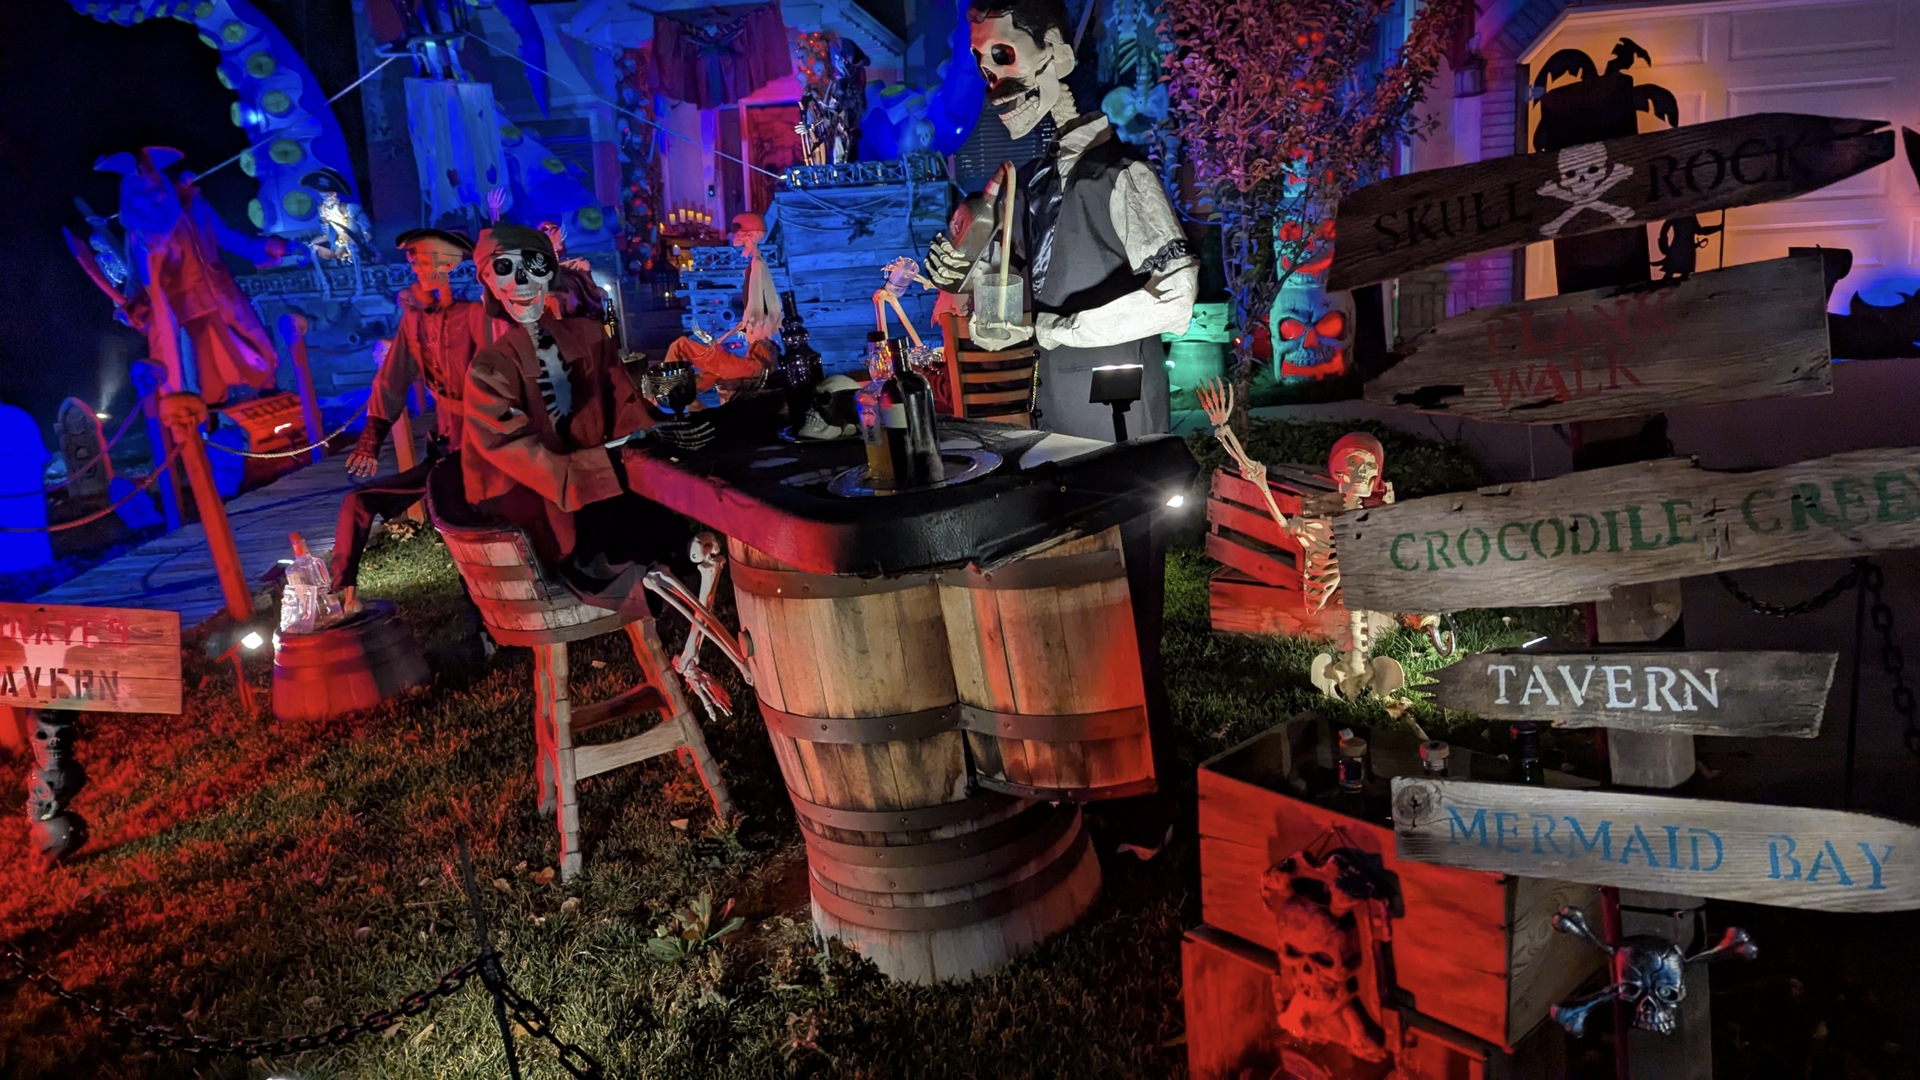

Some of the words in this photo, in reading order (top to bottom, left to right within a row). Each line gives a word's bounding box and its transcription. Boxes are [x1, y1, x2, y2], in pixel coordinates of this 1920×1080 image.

[1373, 181, 1533, 251] SKULL
[1647, 131, 1815, 201] ROCK
[1486, 290, 1677, 358] PLANK
[1489, 345, 1645, 406] WALK
[1390, 498, 1699, 573] CROCODILE
[1740, 464, 1920, 534] CREE
[1487, 664, 1719, 712] TAVERN
[1447, 806, 1724, 872] MERMAID
[1767, 834, 1896, 890] BAY
